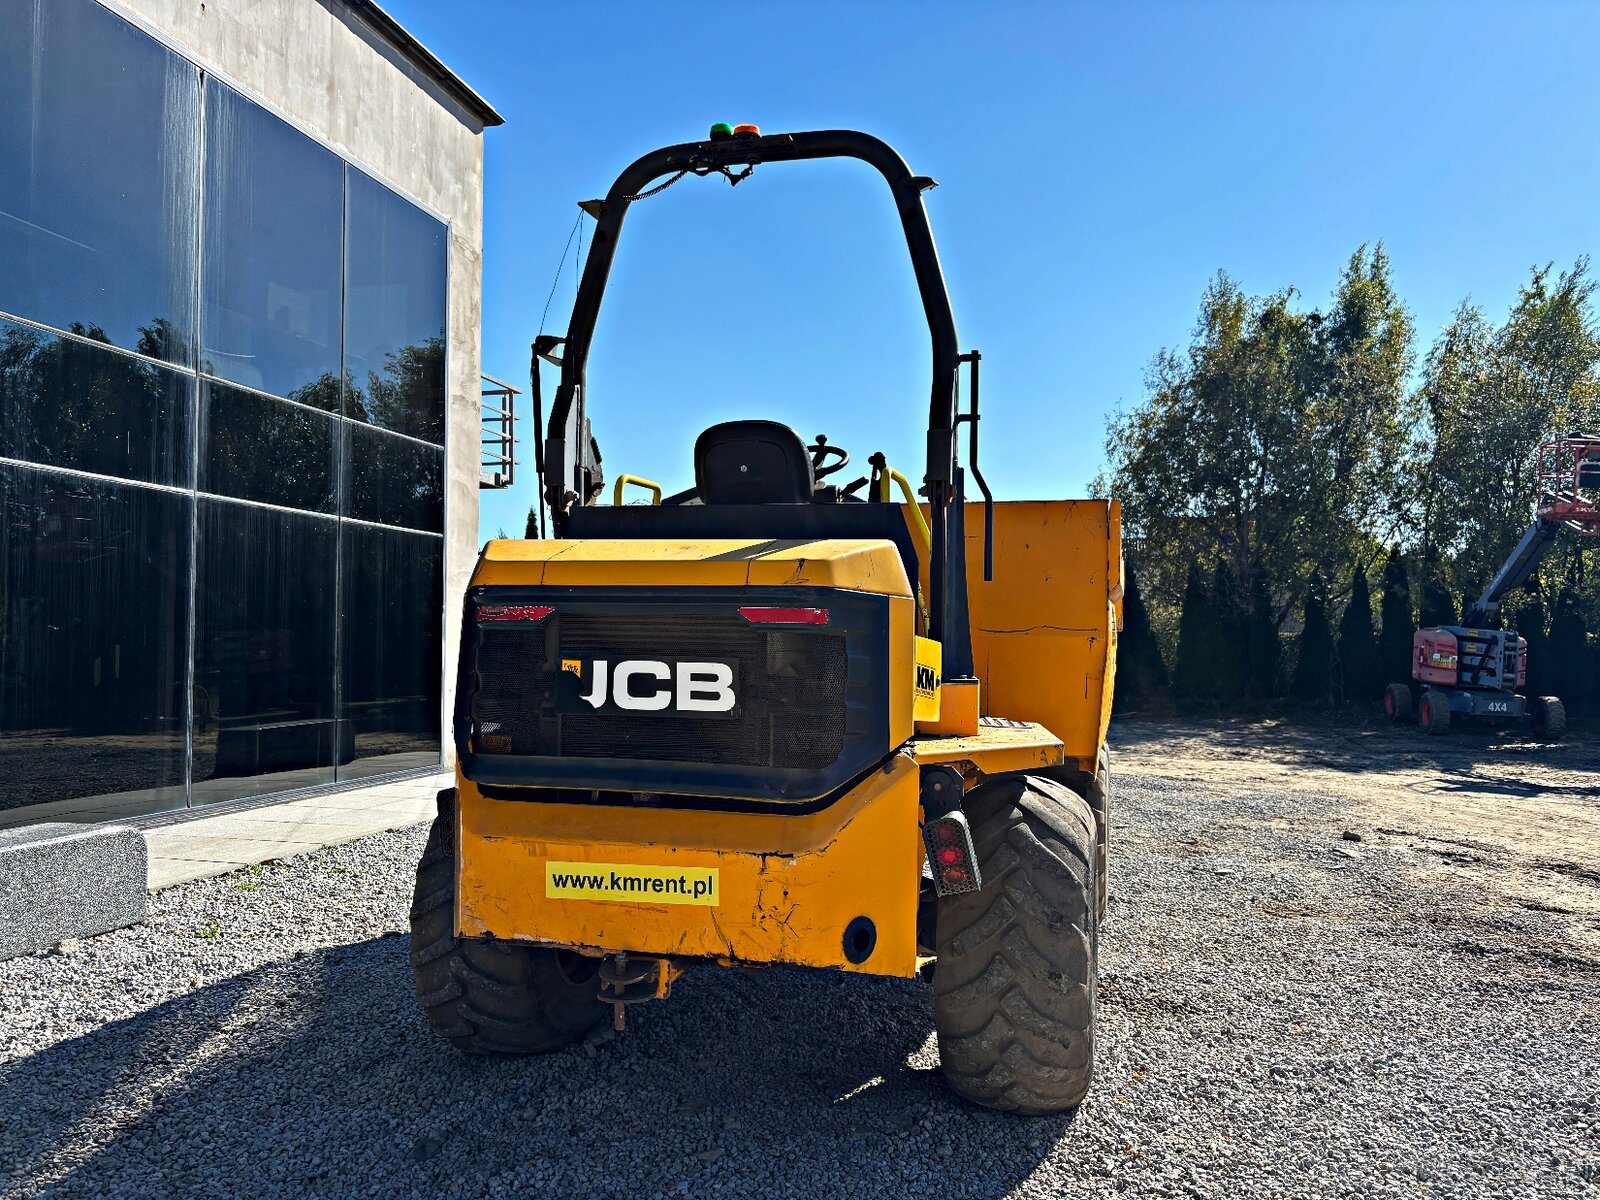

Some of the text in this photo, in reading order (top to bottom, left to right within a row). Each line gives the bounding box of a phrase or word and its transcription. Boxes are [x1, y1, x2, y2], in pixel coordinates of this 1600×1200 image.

[579, 660, 736, 712] JCB
[916, 665, 935, 692] KM
[552, 871, 713, 899] www.kmrent.pl
